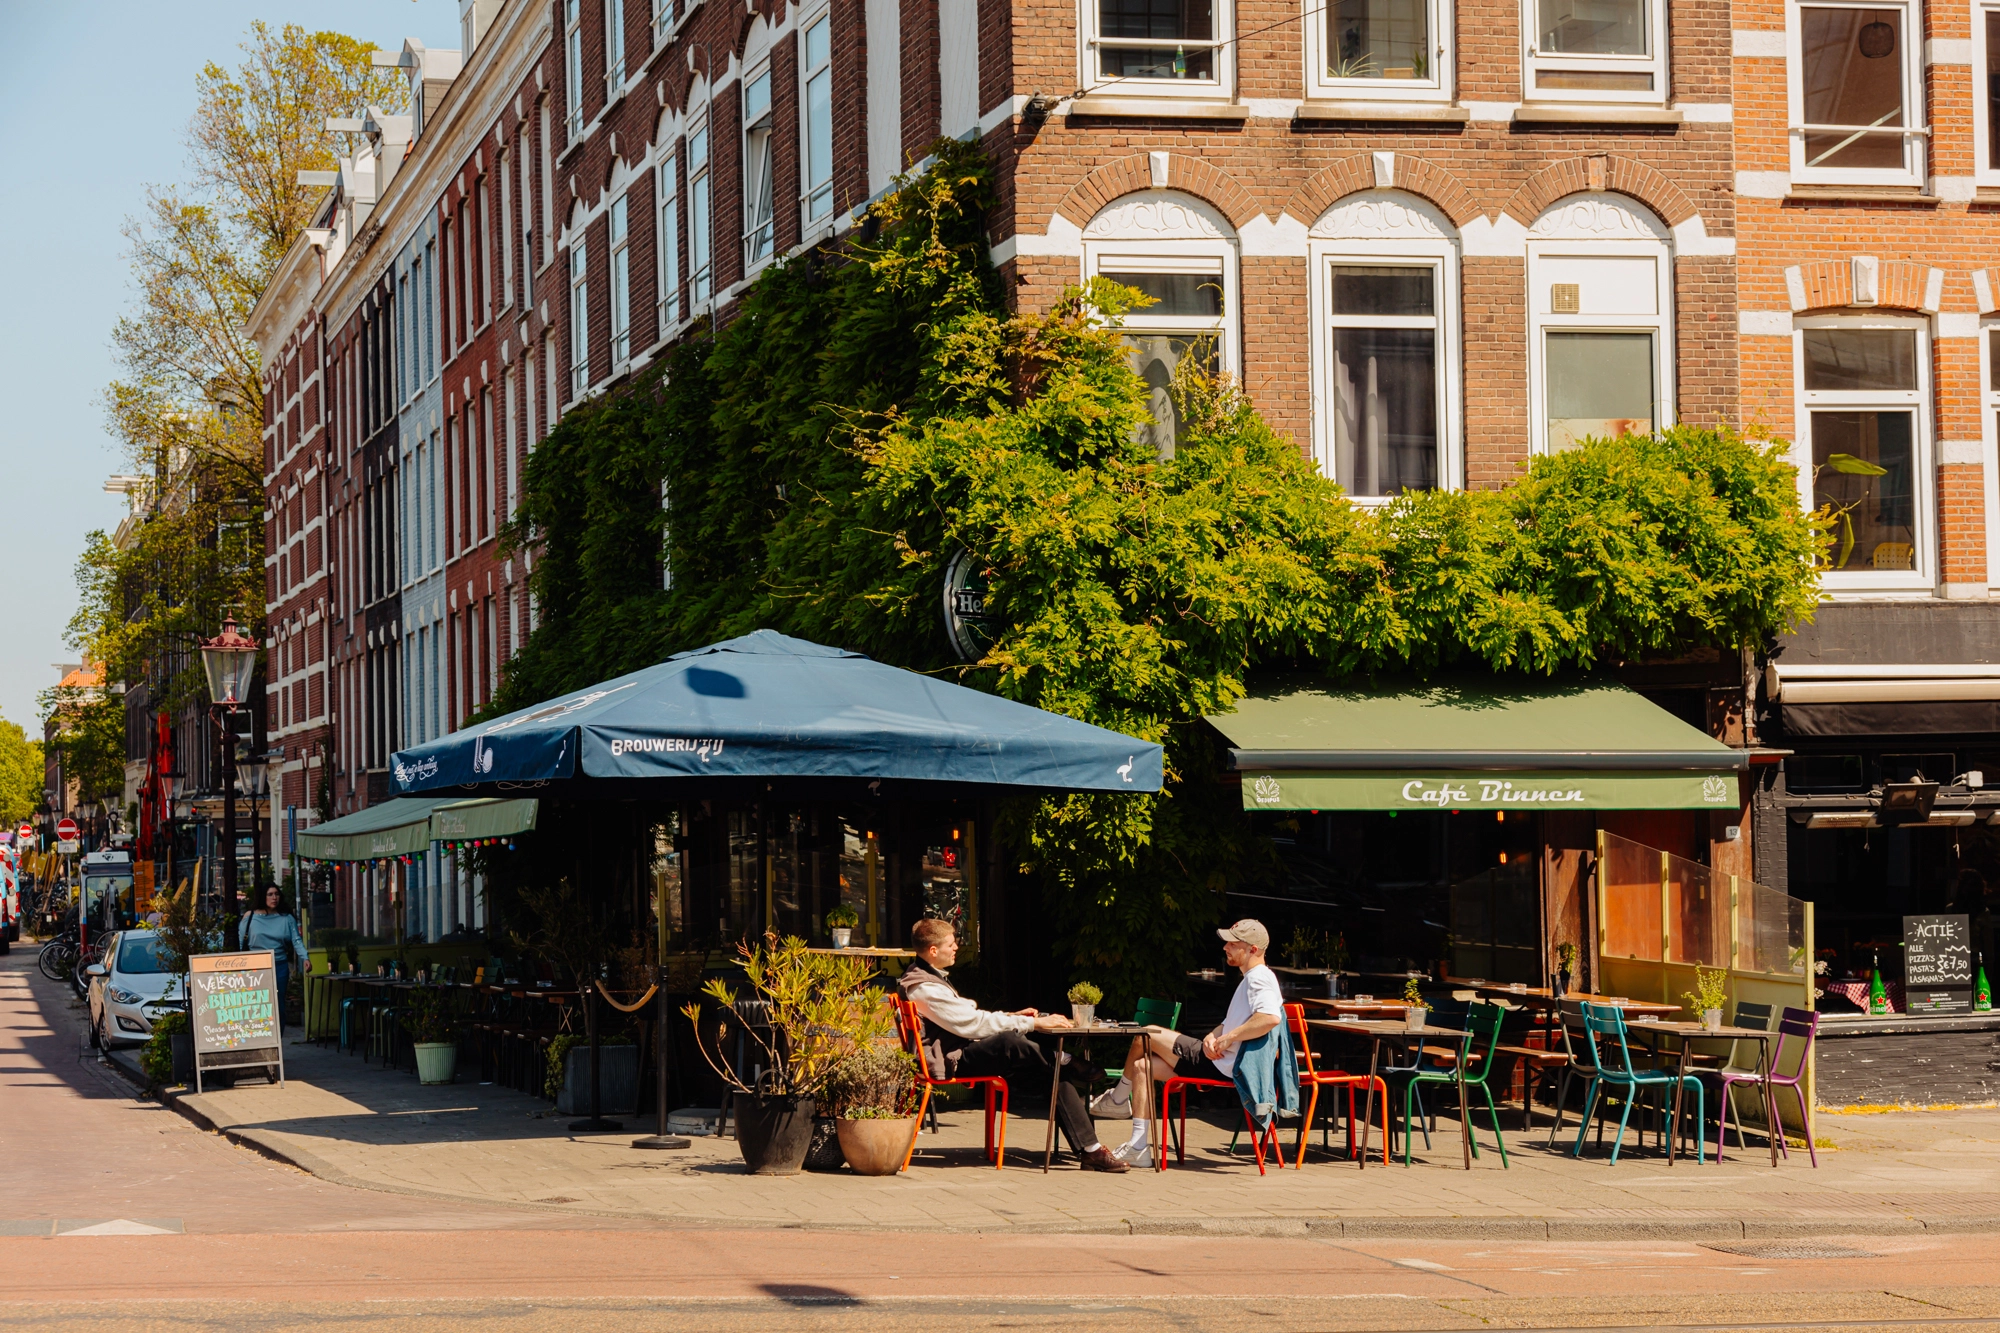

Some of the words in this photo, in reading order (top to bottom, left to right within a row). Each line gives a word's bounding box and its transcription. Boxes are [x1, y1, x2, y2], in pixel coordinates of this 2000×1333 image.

[1402, 780, 1471, 807] Café
[1478, 780, 1585, 802] Binnen
[1729, 828, 1738, 836] 13
[1917, 924, 1954, 937] ACTIE
[1908, 955, 1935, 964] PIZZA'S
[1909, 965, 1935, 974] PASTA'S
[1909, 975, 1944, 983] LASAGNA'S
[208, 989, 269, 1009] BINNEN
[216, 1003, 272, 1024] BUITEN
